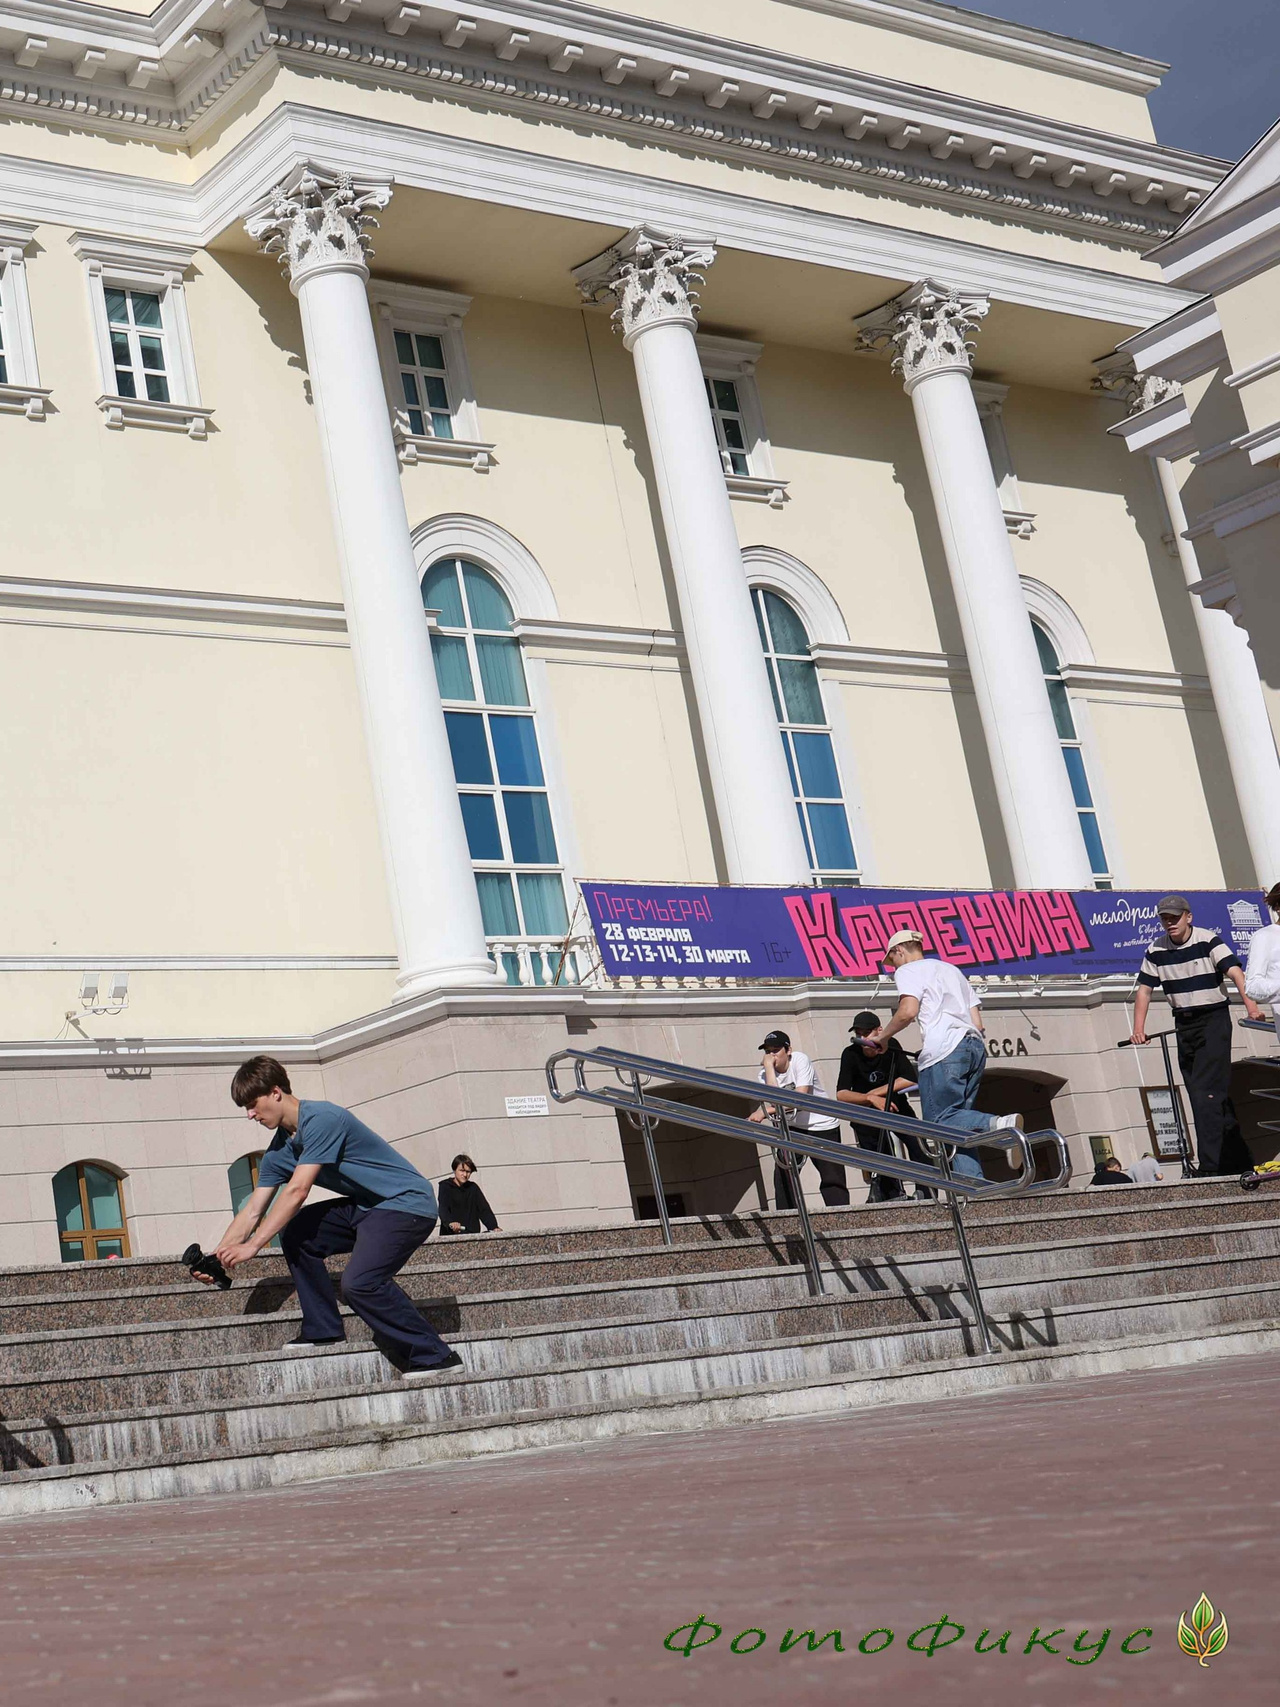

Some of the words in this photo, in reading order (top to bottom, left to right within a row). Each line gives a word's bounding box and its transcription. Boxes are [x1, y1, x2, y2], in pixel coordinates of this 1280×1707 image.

[602, 923, 625, 941] 28
[627, 927, 693, 942] ФЕВРАЛЯ
[783, 891, 1091, 977] КАРЕНИН
[609, 944, 682, 964] 12-13-14,
[685, 946, 705, 963] 30
[705, 949, 752, 964] МАРТА
[761, 942, 792, 963] 16+
